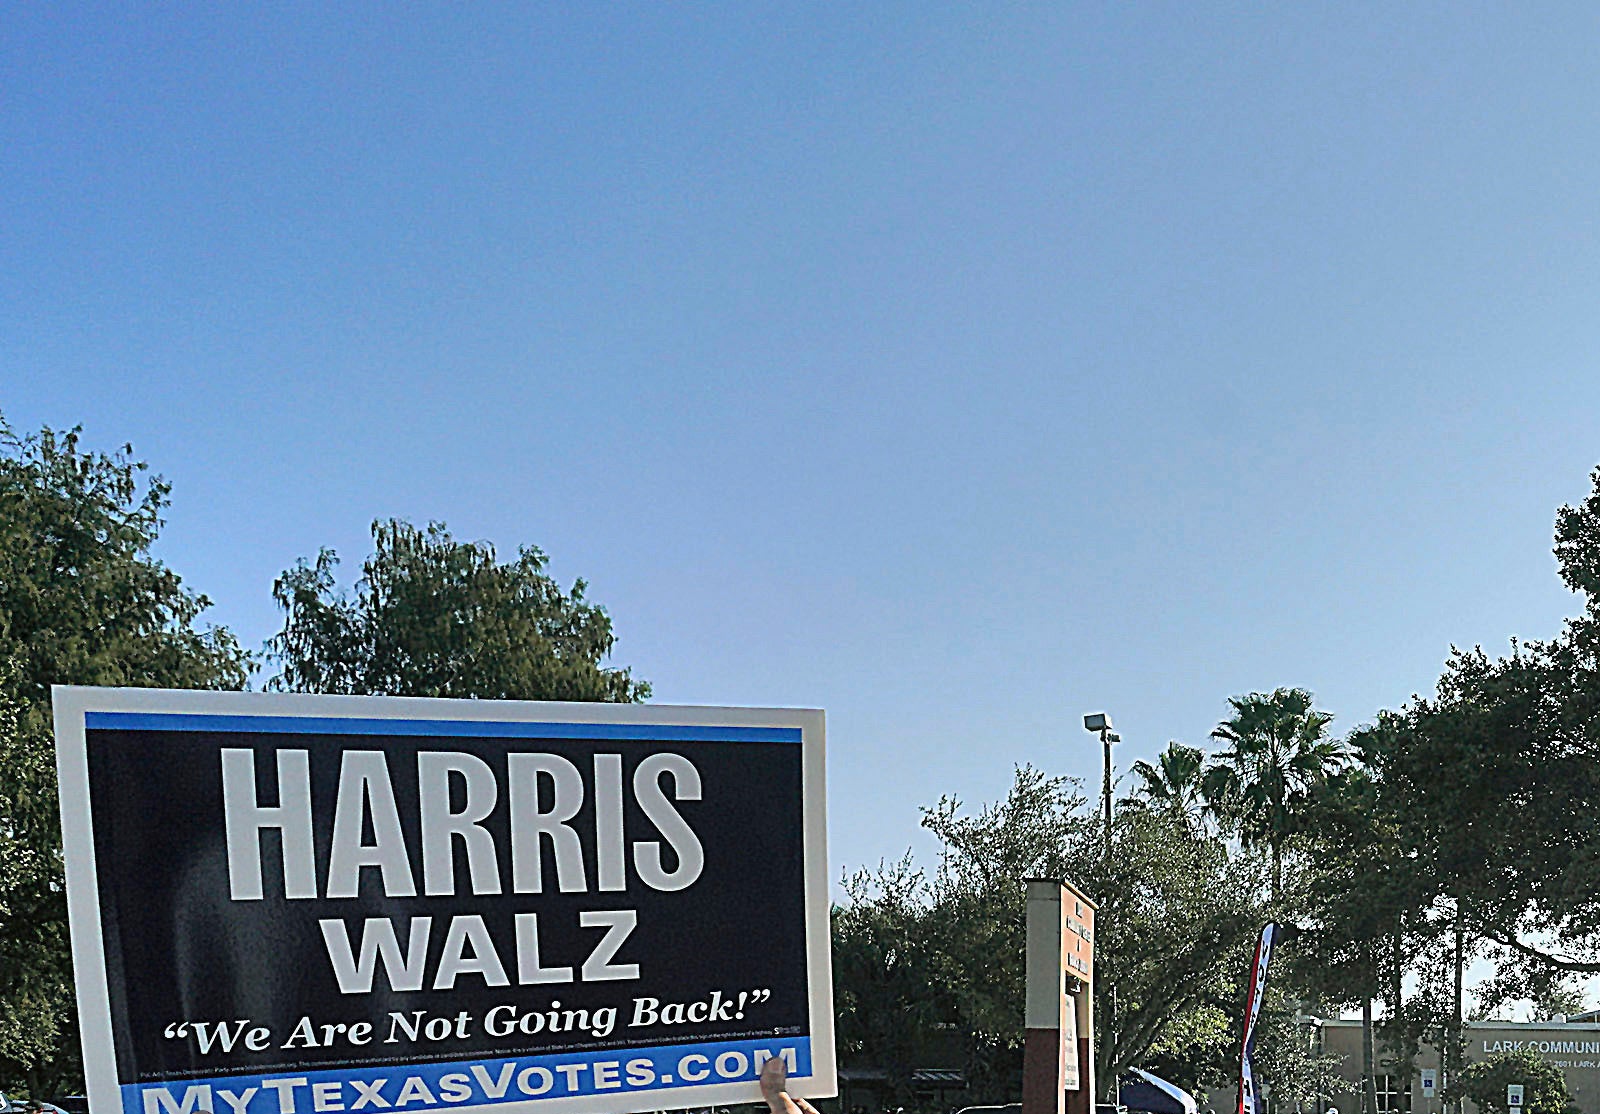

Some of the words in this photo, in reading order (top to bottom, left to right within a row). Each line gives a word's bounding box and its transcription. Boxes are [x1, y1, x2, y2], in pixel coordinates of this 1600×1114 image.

[221, 747, 706, 901] HARRIS
[320, 909, 641, 995] WALZ
[290, 1009, 373, 1050] Are
[384, 1007, 474, 1045] Not
[485, 1000, 618, 1040] Going
[1483, 1040, 1525, 1054] LARK
[1573, 1060, 1596, 1069] LARK
